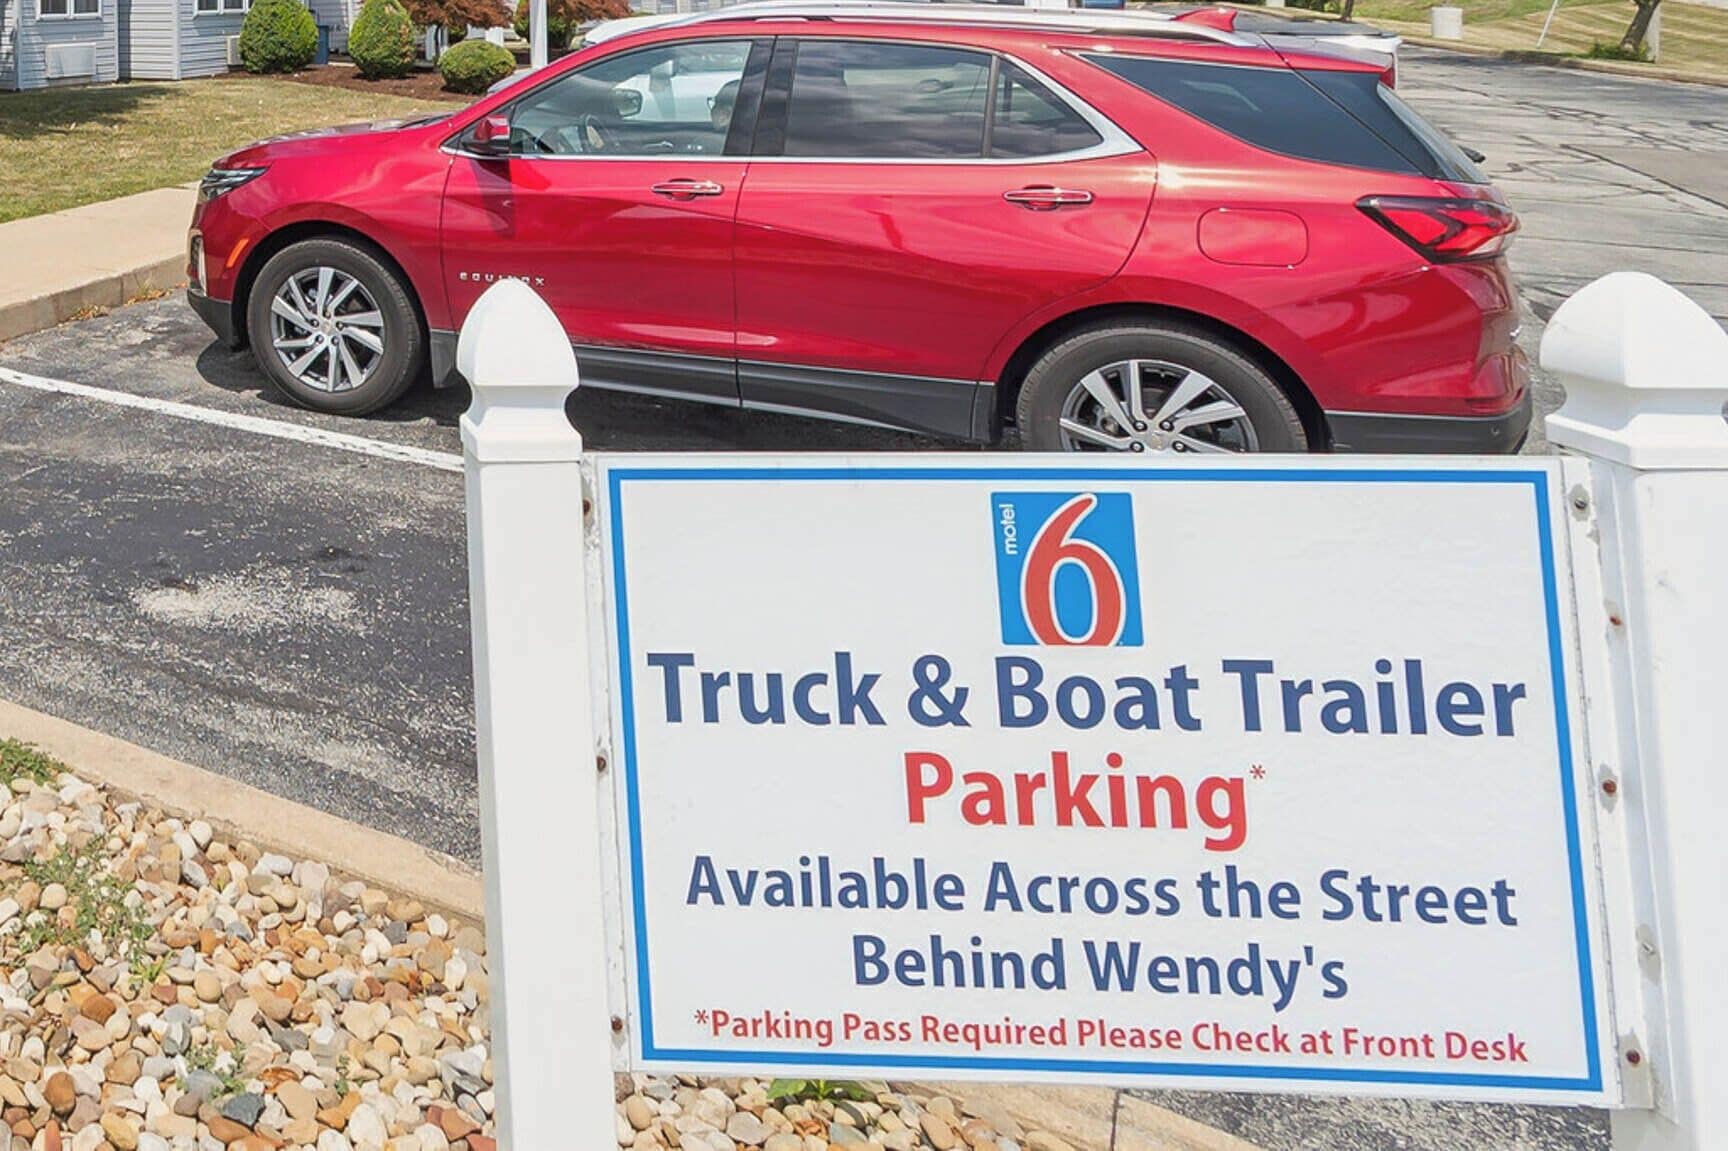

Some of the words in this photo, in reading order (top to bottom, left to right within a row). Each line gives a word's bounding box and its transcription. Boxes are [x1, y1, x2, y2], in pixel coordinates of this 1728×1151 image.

[999, 503, 1019, 556] motel
[1019, 492, 1128, 647] 6
[646, 651, 887, 727] Truck
[907, 654, 972, 729] &
[994, 655, 1203, 733] Boat
[1221, 658, 1528, 738] Trailer
[686, 855, 967, 913] Available
[983, 861, 1182, 918] Across
[1195, 864, 1302, 921] the
[1319, 869, 1520, 928] Street
[852, 934, 1068, 992] Behind
[1082, 940, 1349, 1014] Wendy's
[842, 1013, 914, 1043] Pass
[920, 1015, 1069, 1052] Required
[1077, 1018, 1184, 1051] Please
[1191, 1022, 1292, 1055] Check
[1300, 1030, 1335, 1056] at
[1342, 1026, 1438, 1060] Front
[1444, 1031, 1529, 1063] Desk
